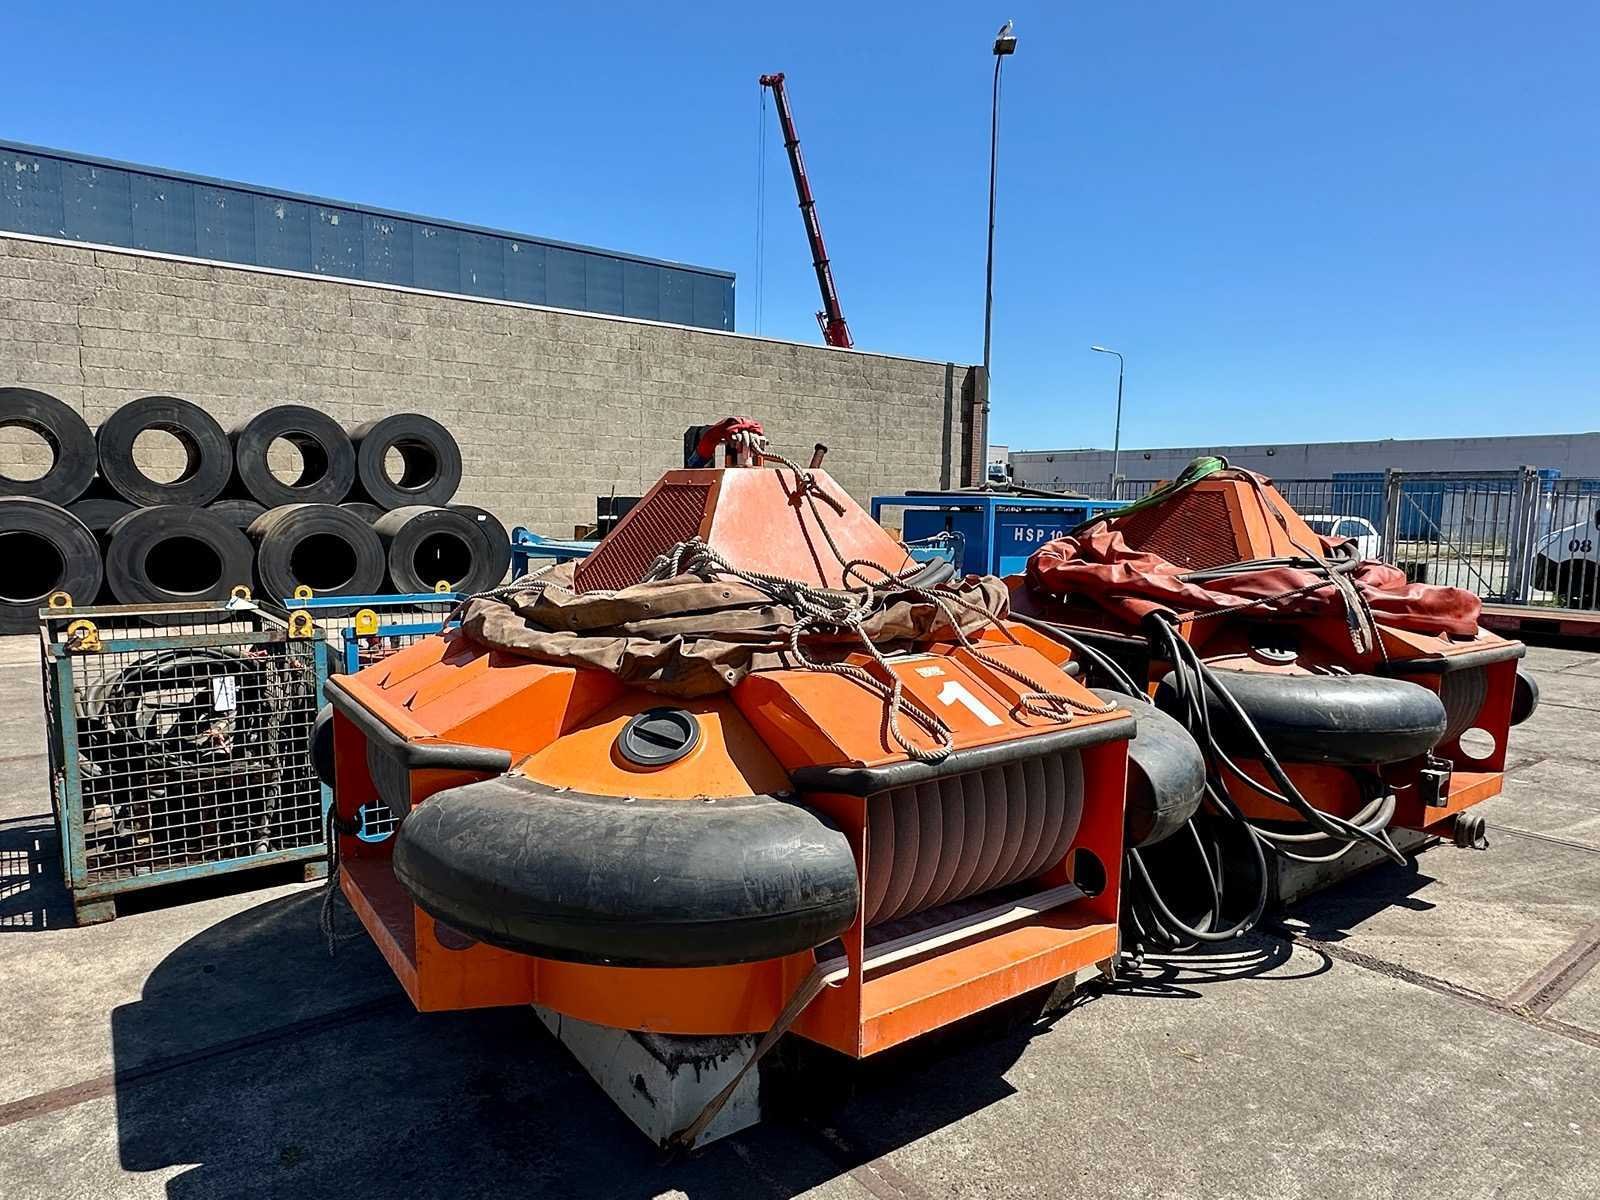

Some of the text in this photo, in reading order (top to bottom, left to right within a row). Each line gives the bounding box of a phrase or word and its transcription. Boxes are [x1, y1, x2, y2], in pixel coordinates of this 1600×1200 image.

[1014, 527, 1044, 542] HSP
[1568, 539, 1592, 552] 08
[937, 680, 1004, 727] 1
